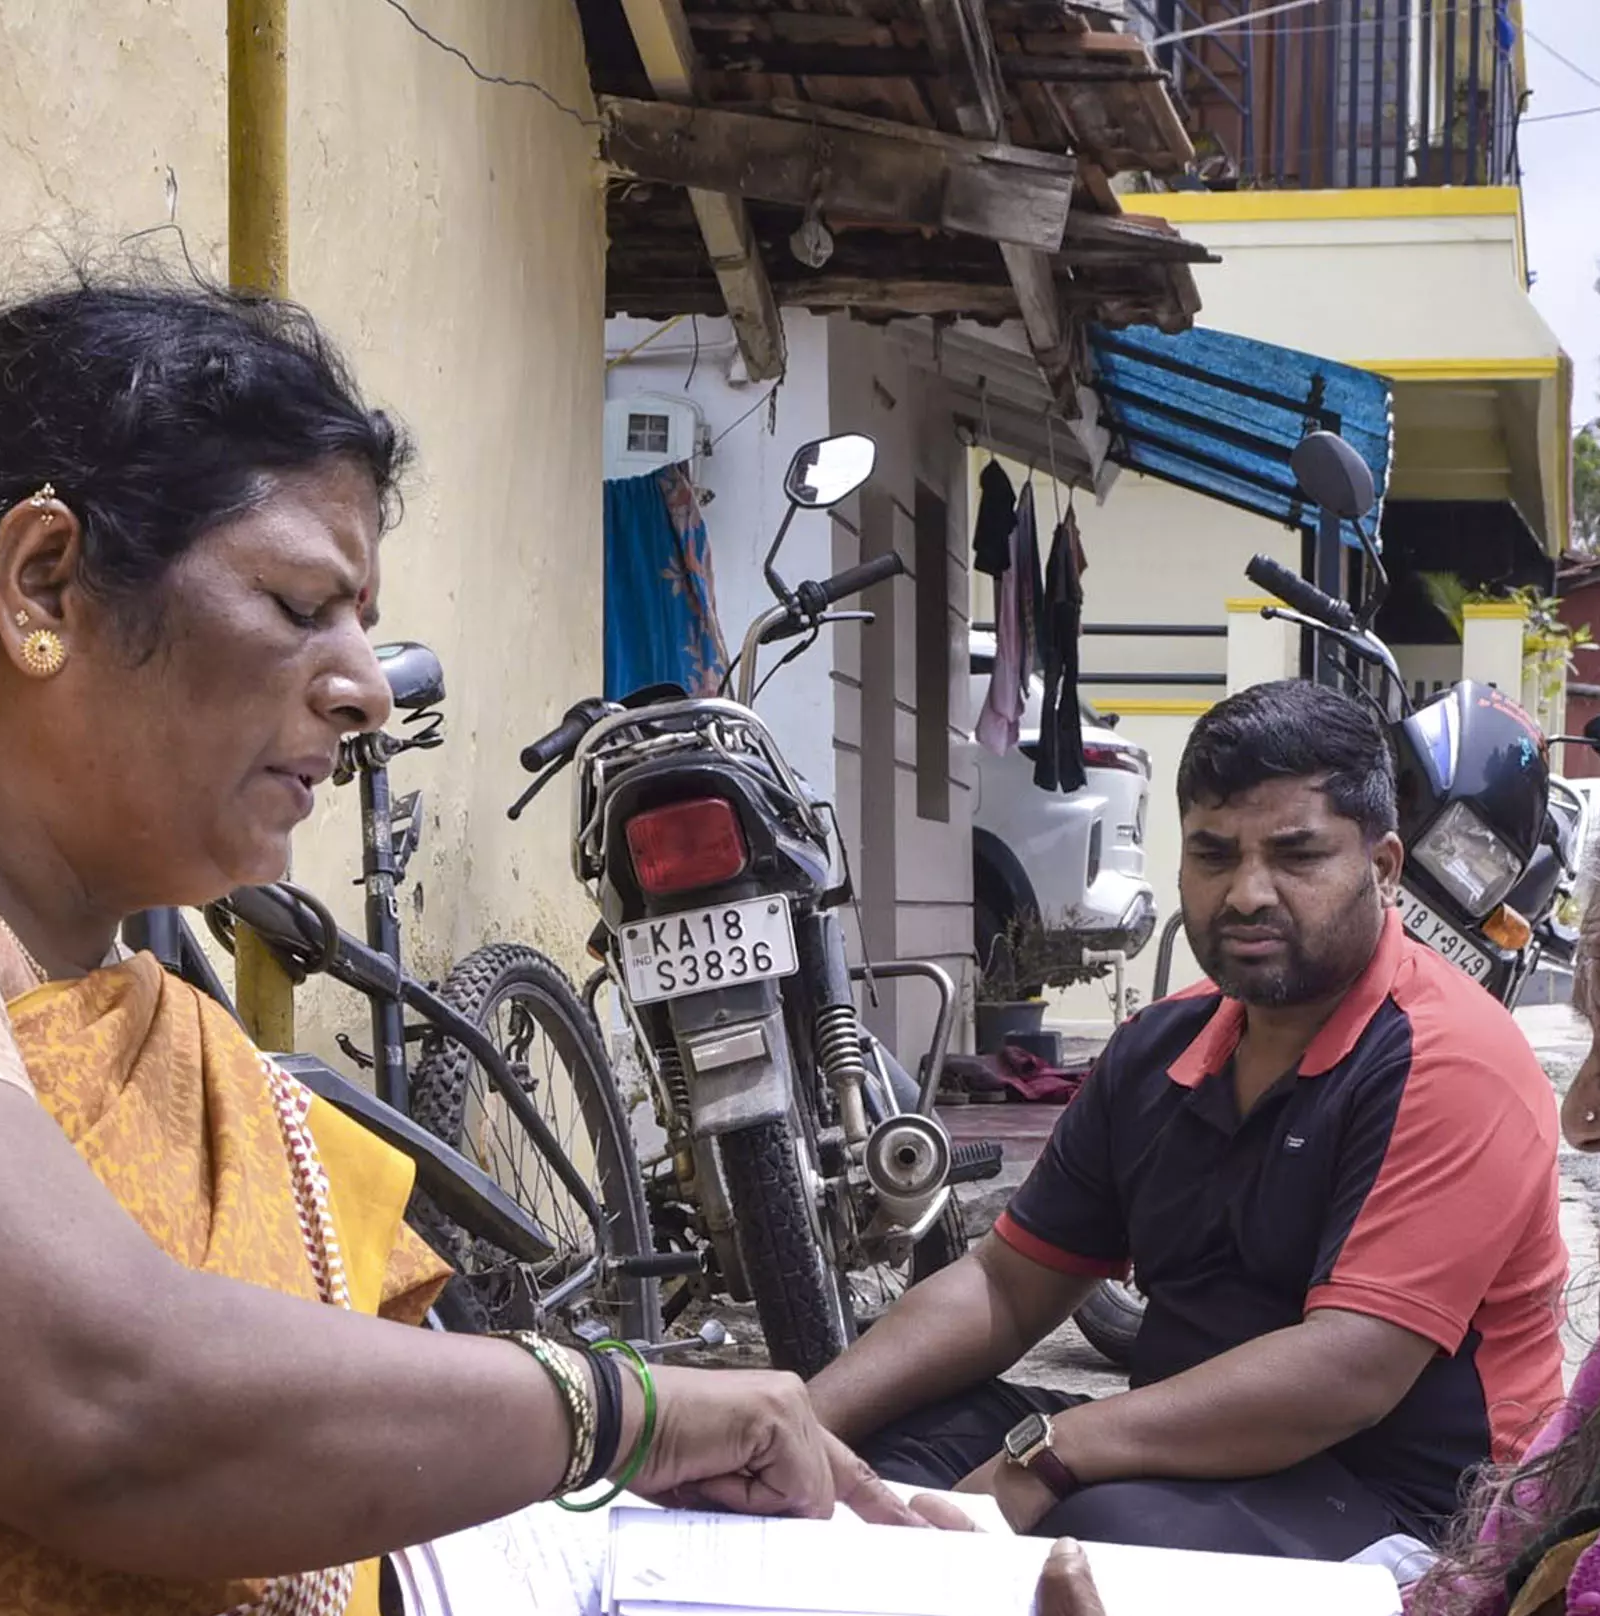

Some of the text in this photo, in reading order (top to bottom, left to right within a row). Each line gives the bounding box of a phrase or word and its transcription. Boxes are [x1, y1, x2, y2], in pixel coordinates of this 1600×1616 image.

[651, 910, 743, 955] KA18
[1404, 903, 1428, 929] 18
[1442, 936, 1484, 976] 9149
[632, 954, 651, 969] IND
[657, 942, 772, 991] S3836
